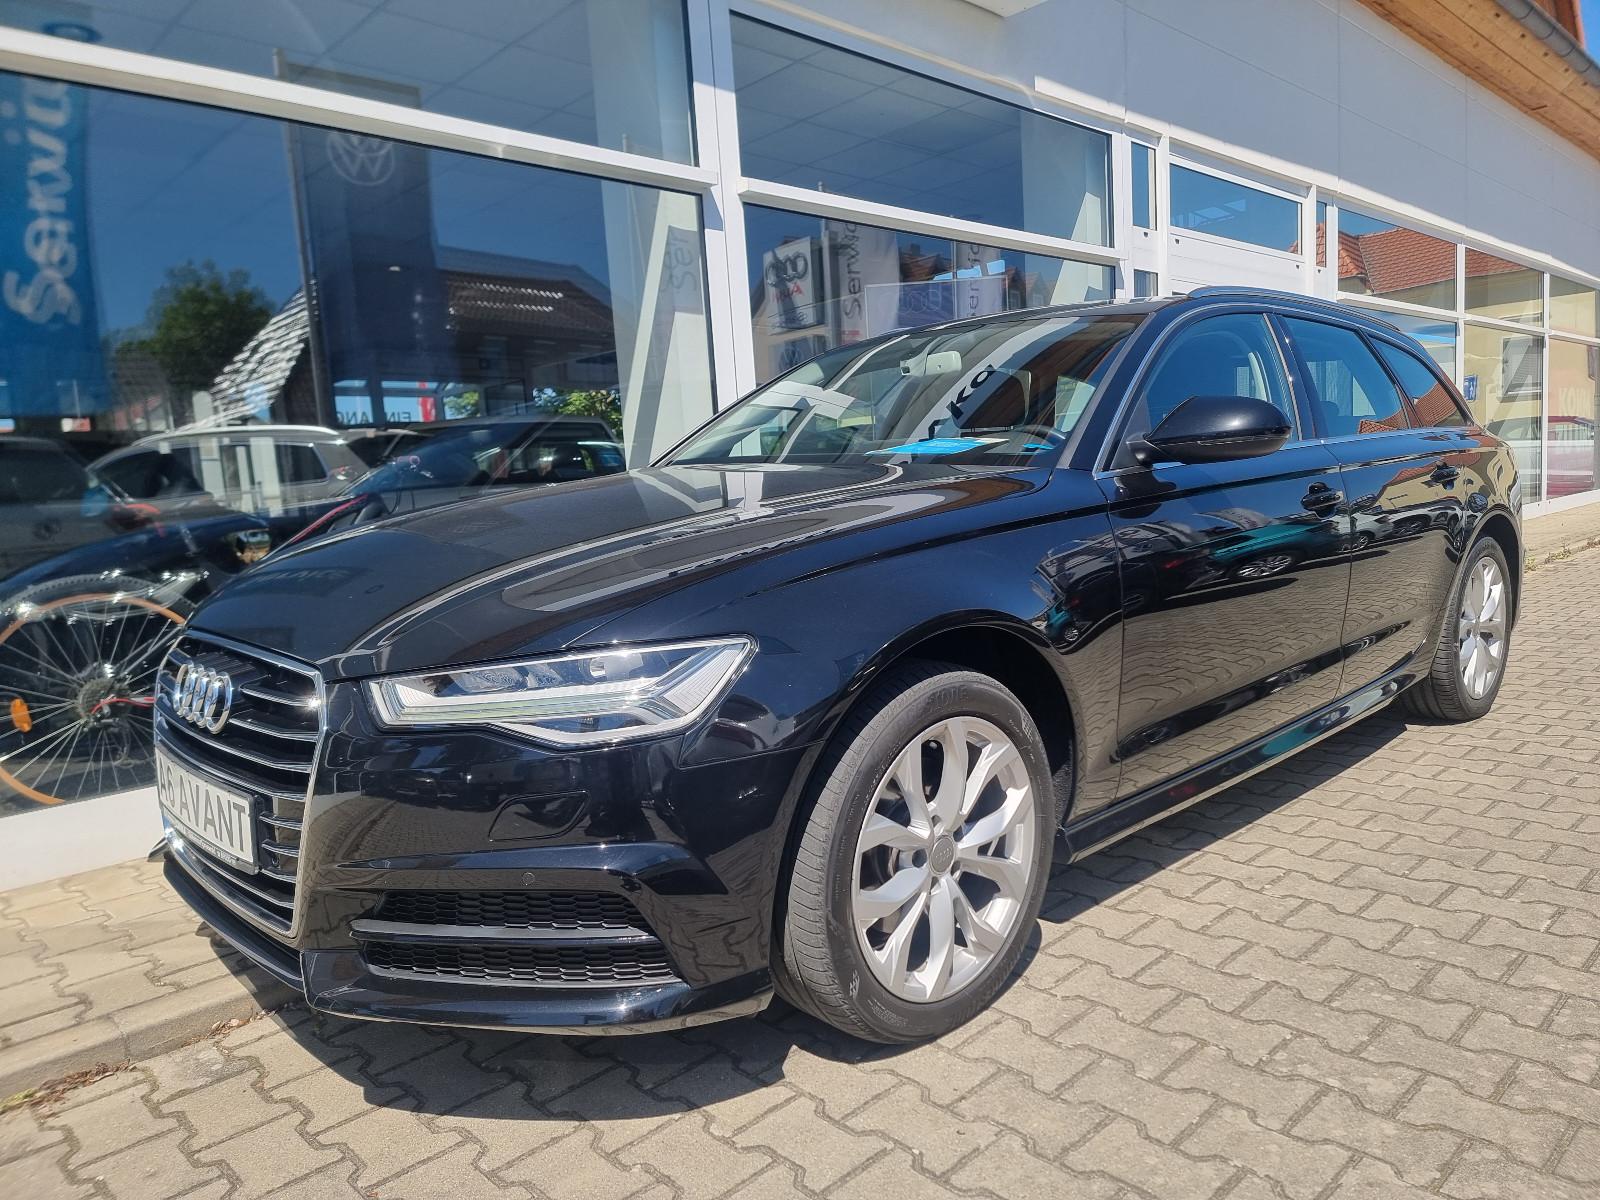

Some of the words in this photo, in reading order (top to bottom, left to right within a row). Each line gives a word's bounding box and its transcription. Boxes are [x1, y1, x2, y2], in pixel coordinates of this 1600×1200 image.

[843, 222, 863, 321] Servic
[159, 756, 176, 809] A6
[179, 773, 246, 853] AVANT
